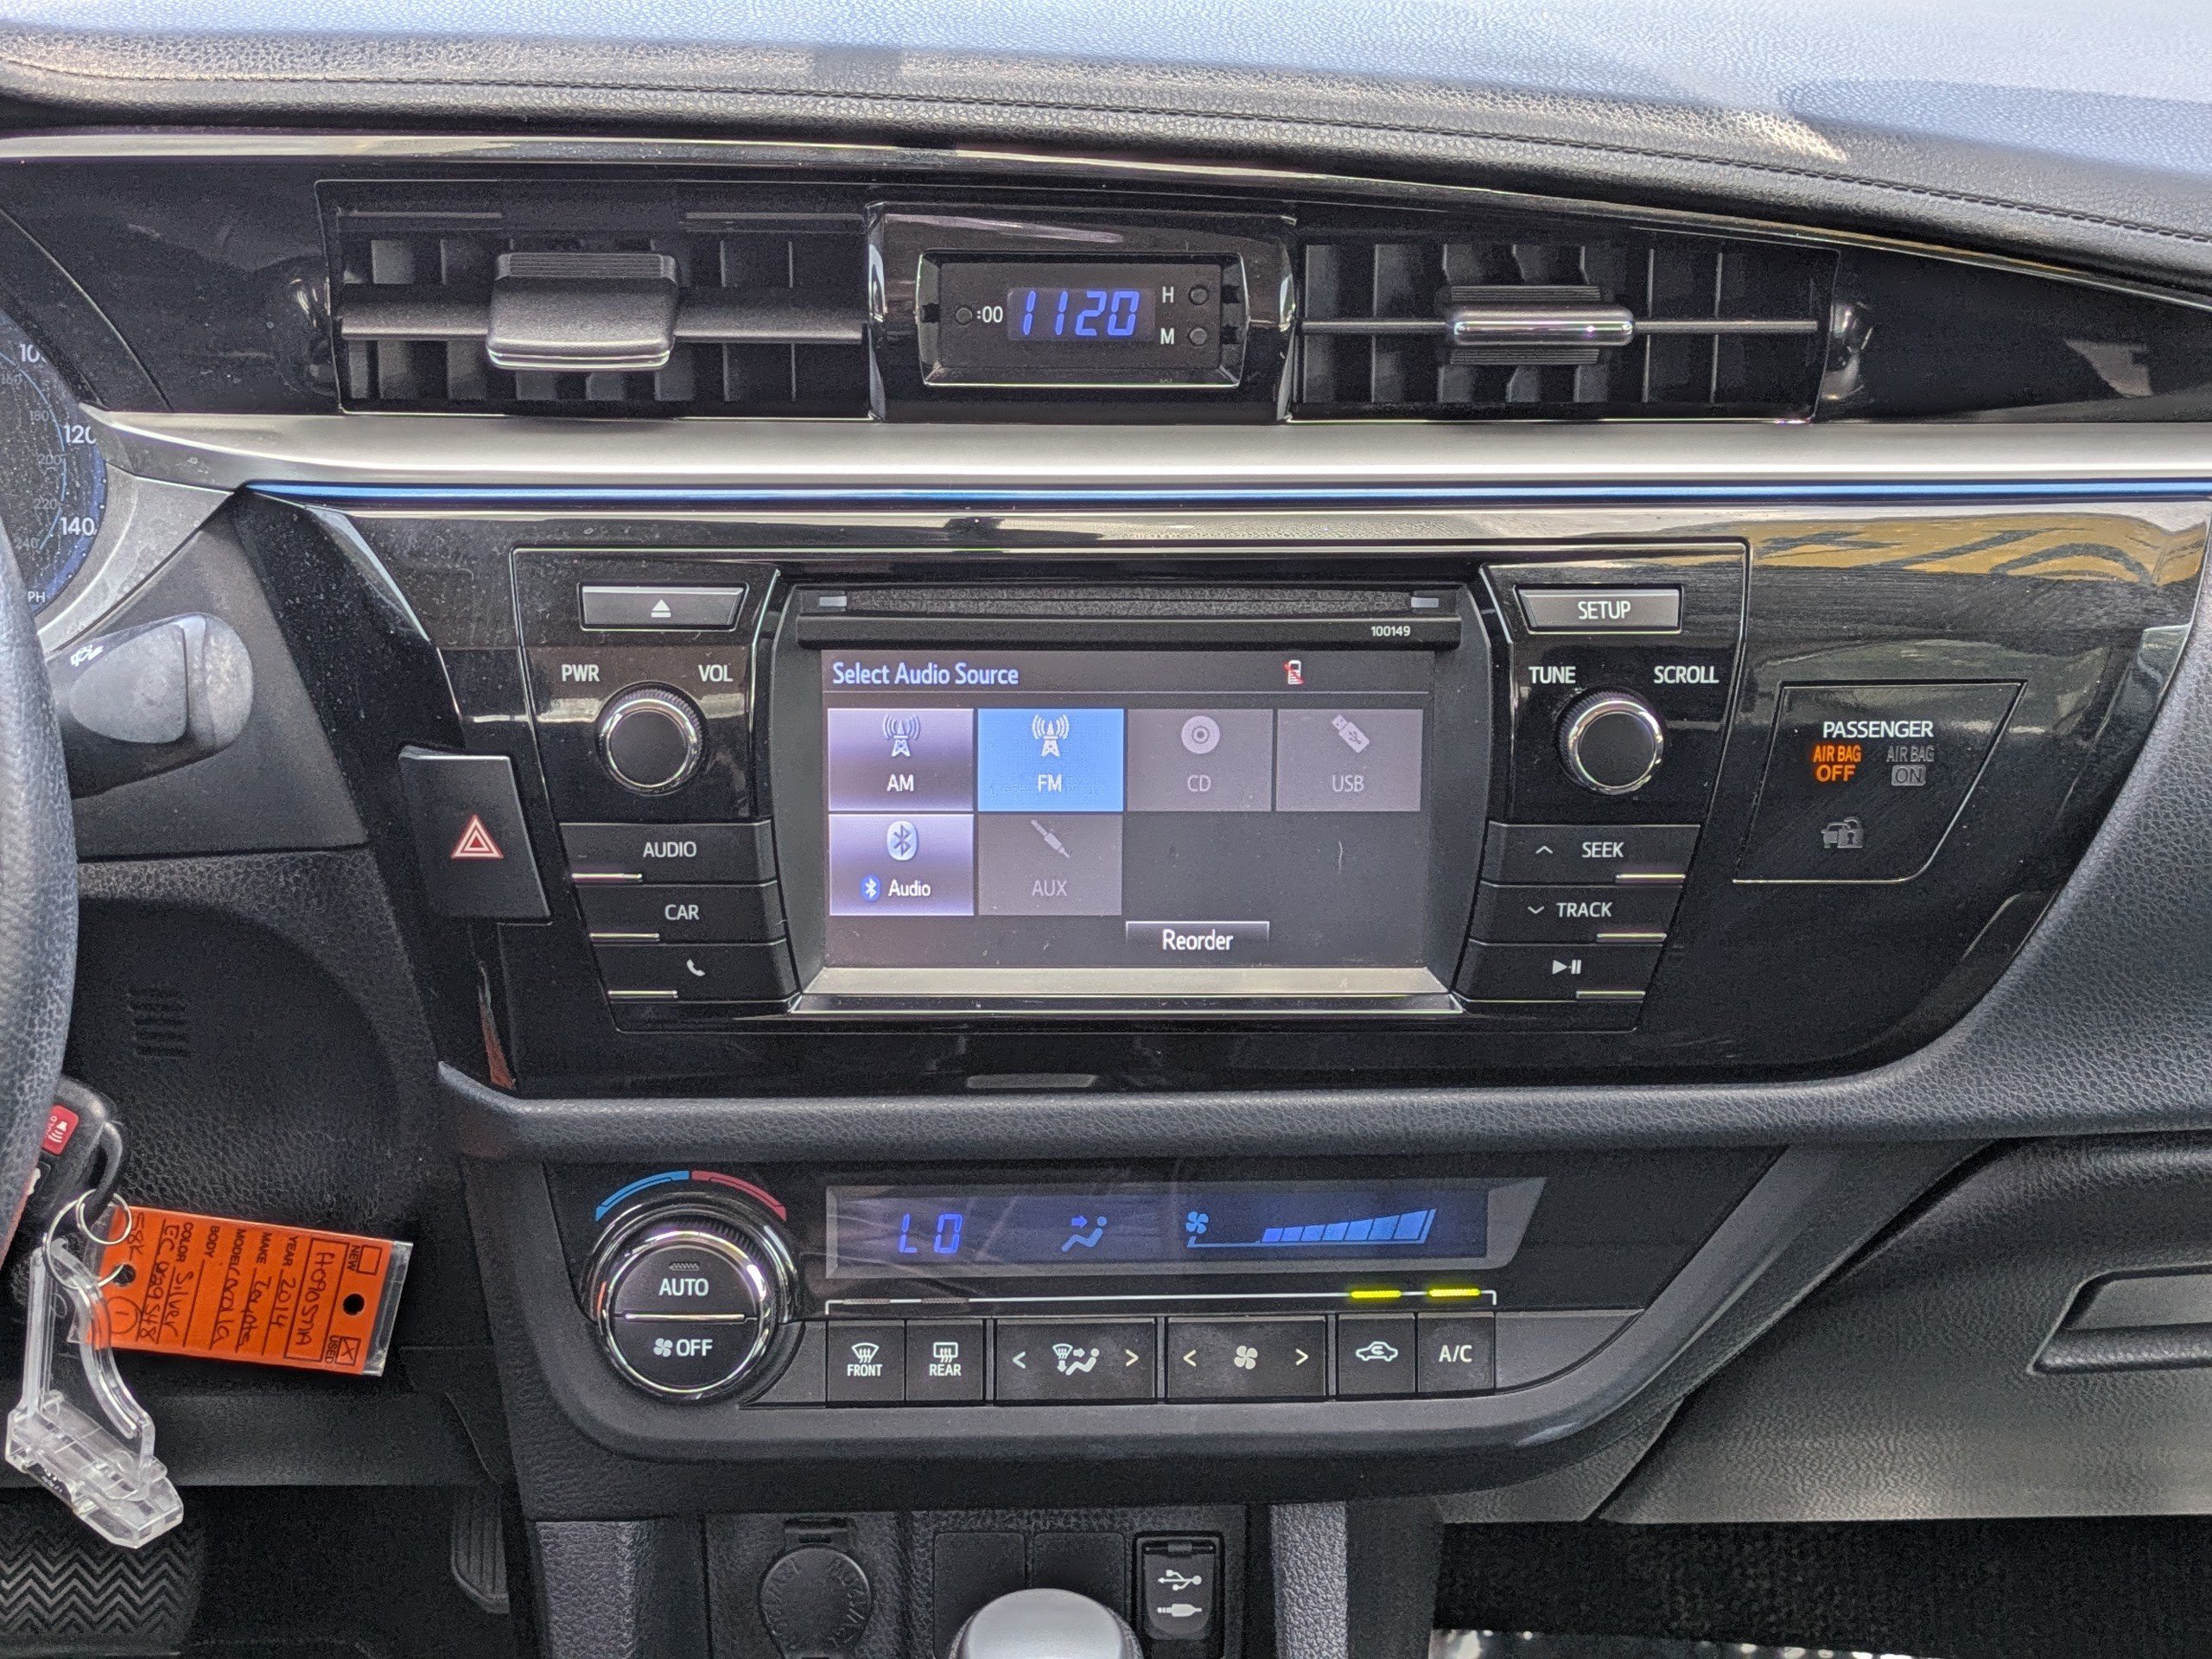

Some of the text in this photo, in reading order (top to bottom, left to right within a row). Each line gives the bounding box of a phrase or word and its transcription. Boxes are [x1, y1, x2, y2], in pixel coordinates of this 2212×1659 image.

[1161, 287, 1175, 303] H
[977, 306, 1003, 323] :00
[1160, 328, 1175, 345] M
[20, 344, 47, 362] 10
[35, 498, 57, 510] 220
[60, 517, 95, 536] 140
[1577, 601, 1631, 620] SETUP
[1370, 626, 1411, 638] 100149
[561, 664, 600, 683] PWR
[698, 664, 733, 683] VOL
[832, 663, 1019, 685] Select Audio Source
[1529, 666, 1576, 684] TUNE
[1653, 666, 1719, 684] SCROLL
[1822, 721, 1934, 739] PASSENGER
[1813, 745, 1862, 763] AIR BAG
[1886, 746, 1934, 762] AIR BAG
[1815, 765, 1856, 783] OFF
[1896, 766, 1923, 784] ON
[887, 774, 915, 793] AM
[1037, 774, 1063, 793] FM
[1186, 774, 1211, 793] CD
[1332, 774, 1364, 793] USB
[643, 842, 697, 858] AUDIO
[1581, 842, 1624, 859] SEEK
[888, 878, 931, 898] Audio
[1032, 880, 1067, 898] AUX
[664, 904, 700, 921] CAR
[1556, 901, 1613, 918] TRACK
[1161, 929, 1235, 951] Reorder
[204, 1225, 220, 1258] BODY
[229, 1228, 247, 1266] MODEL
[256, 1231, 272, 1265] MAKE
[347, 1244, 361, 1272] NEW
[163, 1221, 194, 1338] COLOR Silver
[270, 1235, 299, 1328] YEAR 2014
[658, 1278, 709, 1297] AUTO
[325, 1334, 340, 1364] USED
[676, 1339, 713, 1357] OFF
[1438, 1344, 1472, 1363] A/C
[846, 1364, 883, 1377] FRONT
[929, 1364, 962, 1377] REAR
